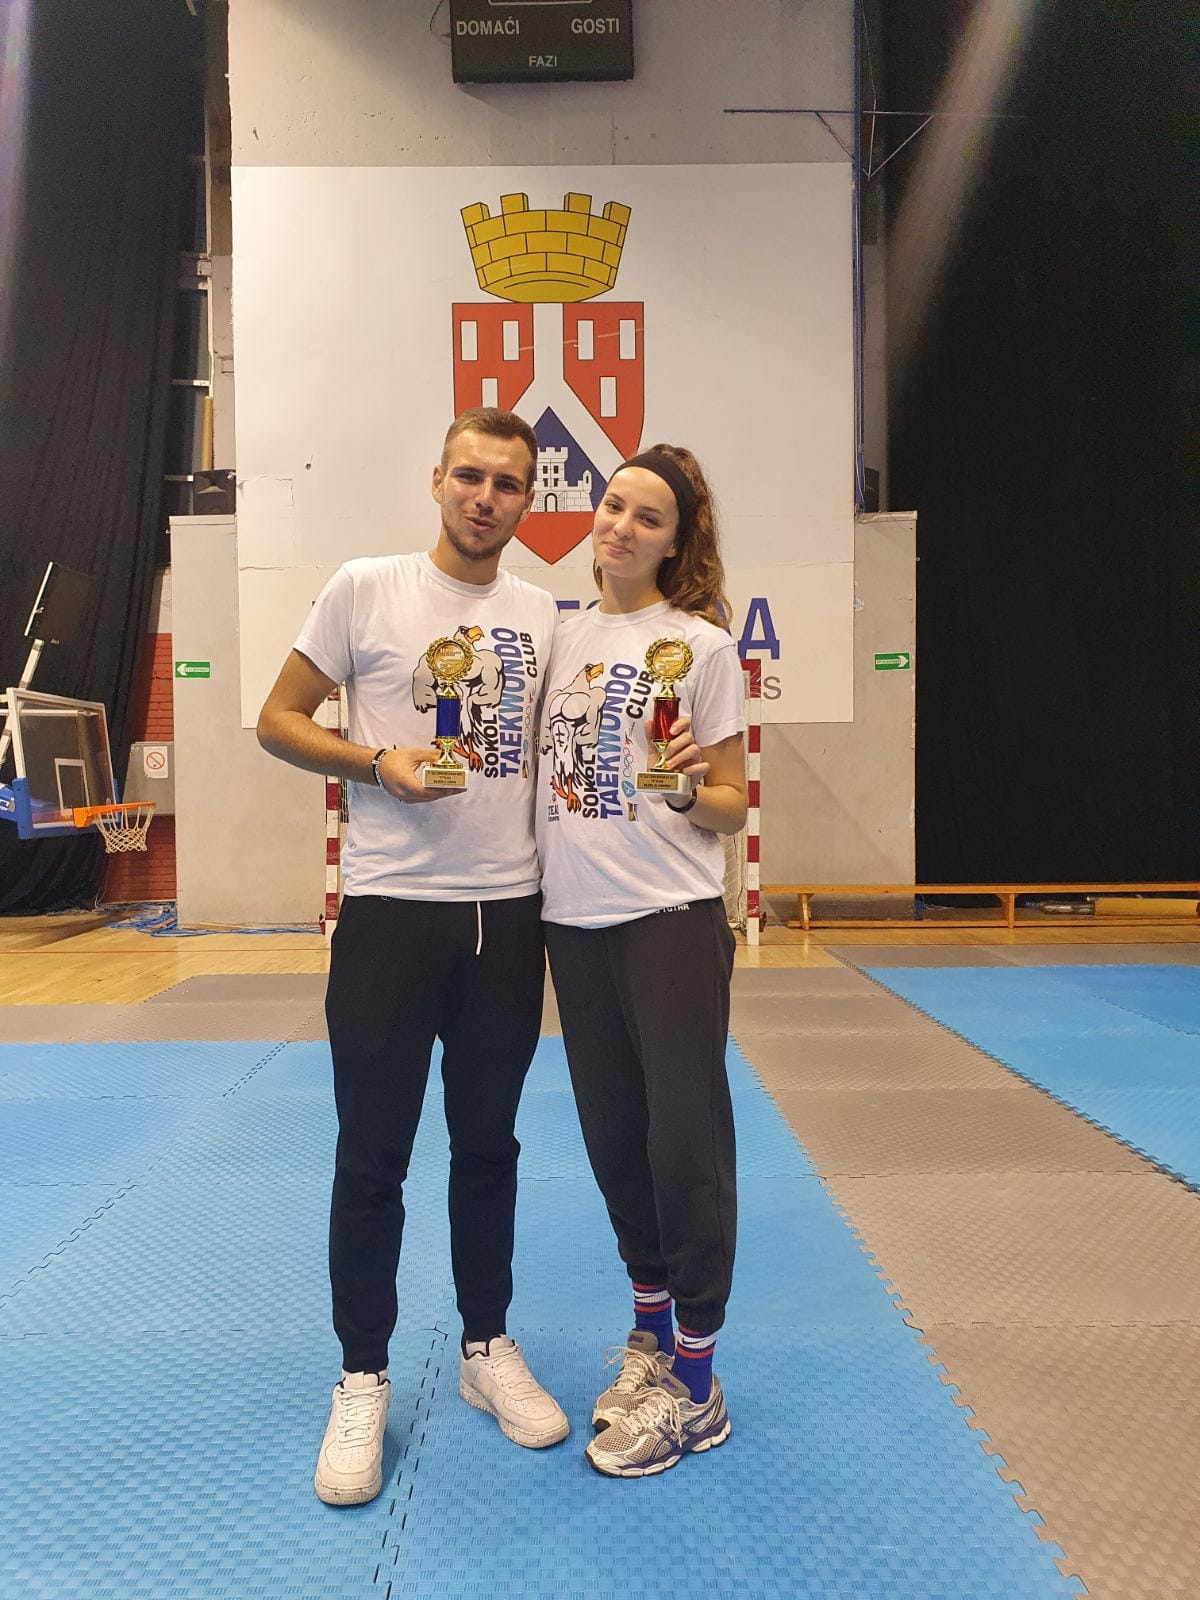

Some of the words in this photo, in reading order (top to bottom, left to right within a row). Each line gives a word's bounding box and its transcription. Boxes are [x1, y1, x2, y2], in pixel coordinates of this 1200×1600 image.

[456, 16, 520, 36] DOMAĆI
[571, 17, 620, 35] GOSTI
[528, 55, 558, 67] FAZI
[520, 632, 538, 678] CLUB
[491, 627, 526, 778] TAEKWONDO
[626, 670, 655, 719] CLUB
[484, 714, 499, 778] SOKOL
[595, 663, 638, 819] TAEKWONDO
[582, 754, 599, 818] SOKOL
